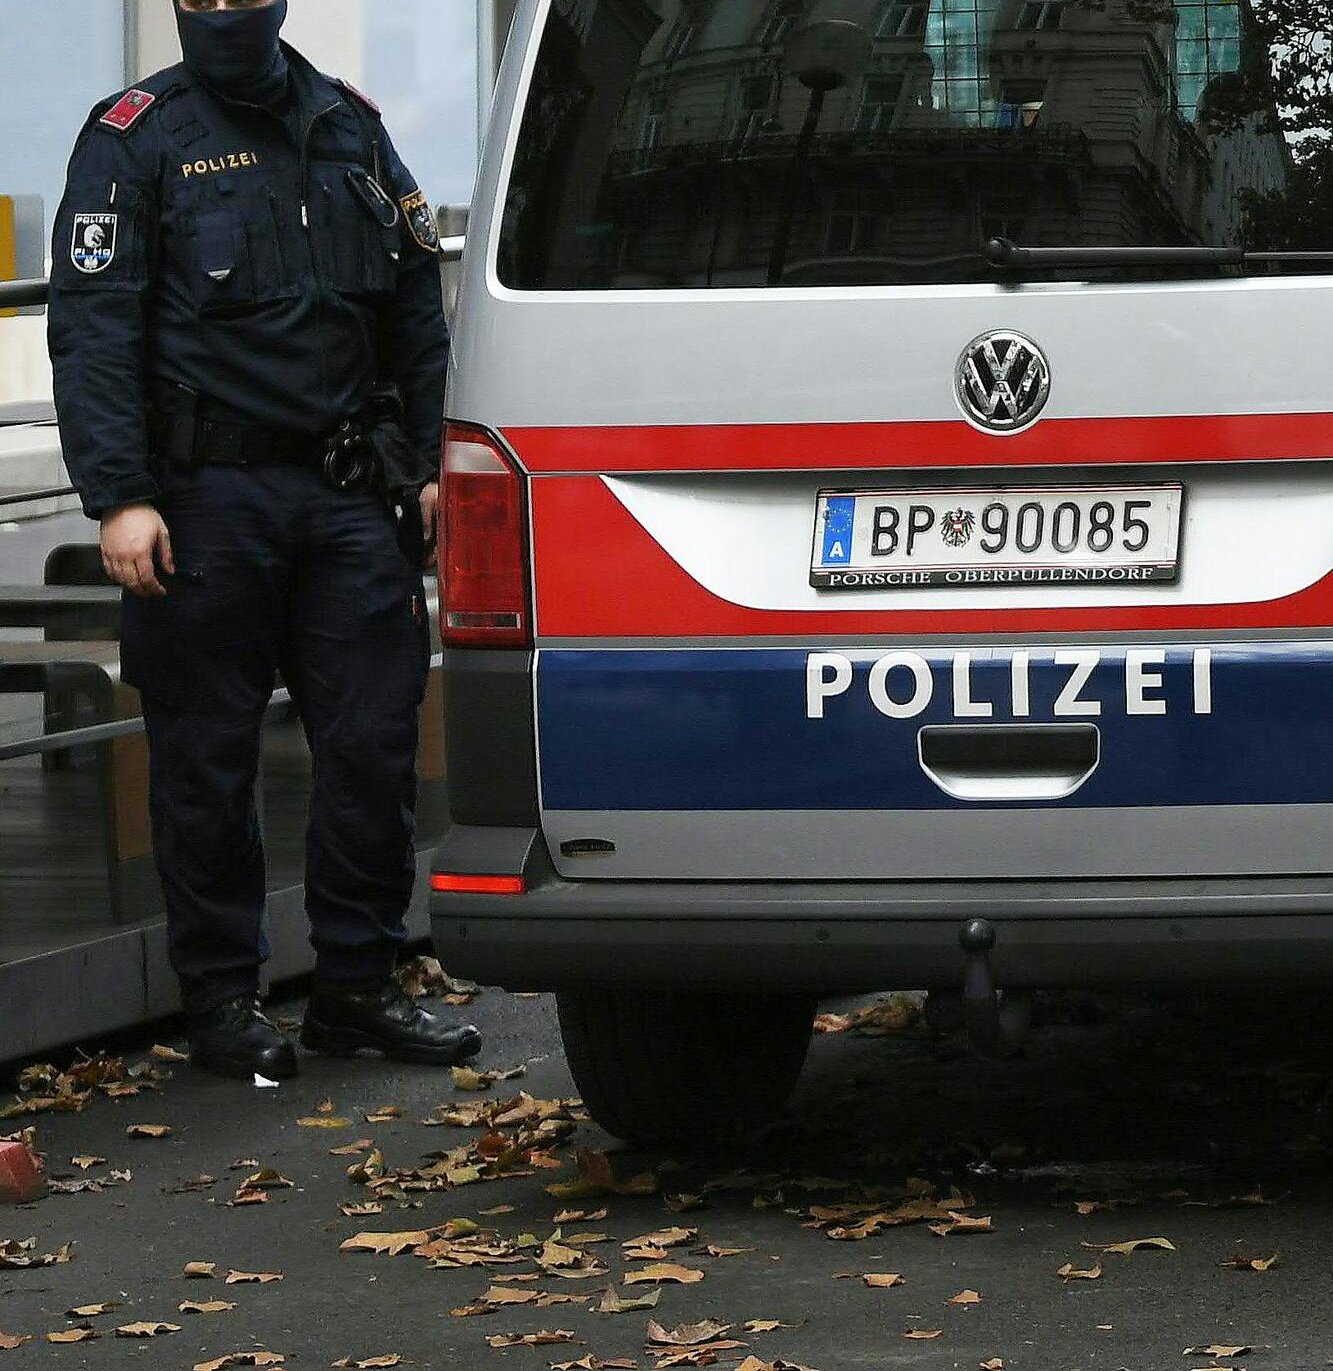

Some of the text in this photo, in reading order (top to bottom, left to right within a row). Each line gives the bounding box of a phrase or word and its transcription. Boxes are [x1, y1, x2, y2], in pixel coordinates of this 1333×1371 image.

[181, 151, 258, 179] POLIZEI
[76, 216, 115, 224] POLIZEI
[828, 500, 1152, 559] A BP 90085
[828, 566, 1155, 587] PORSCHE OBERPULLENDORF
[805, 647, 1213, 720] POLIZEI
